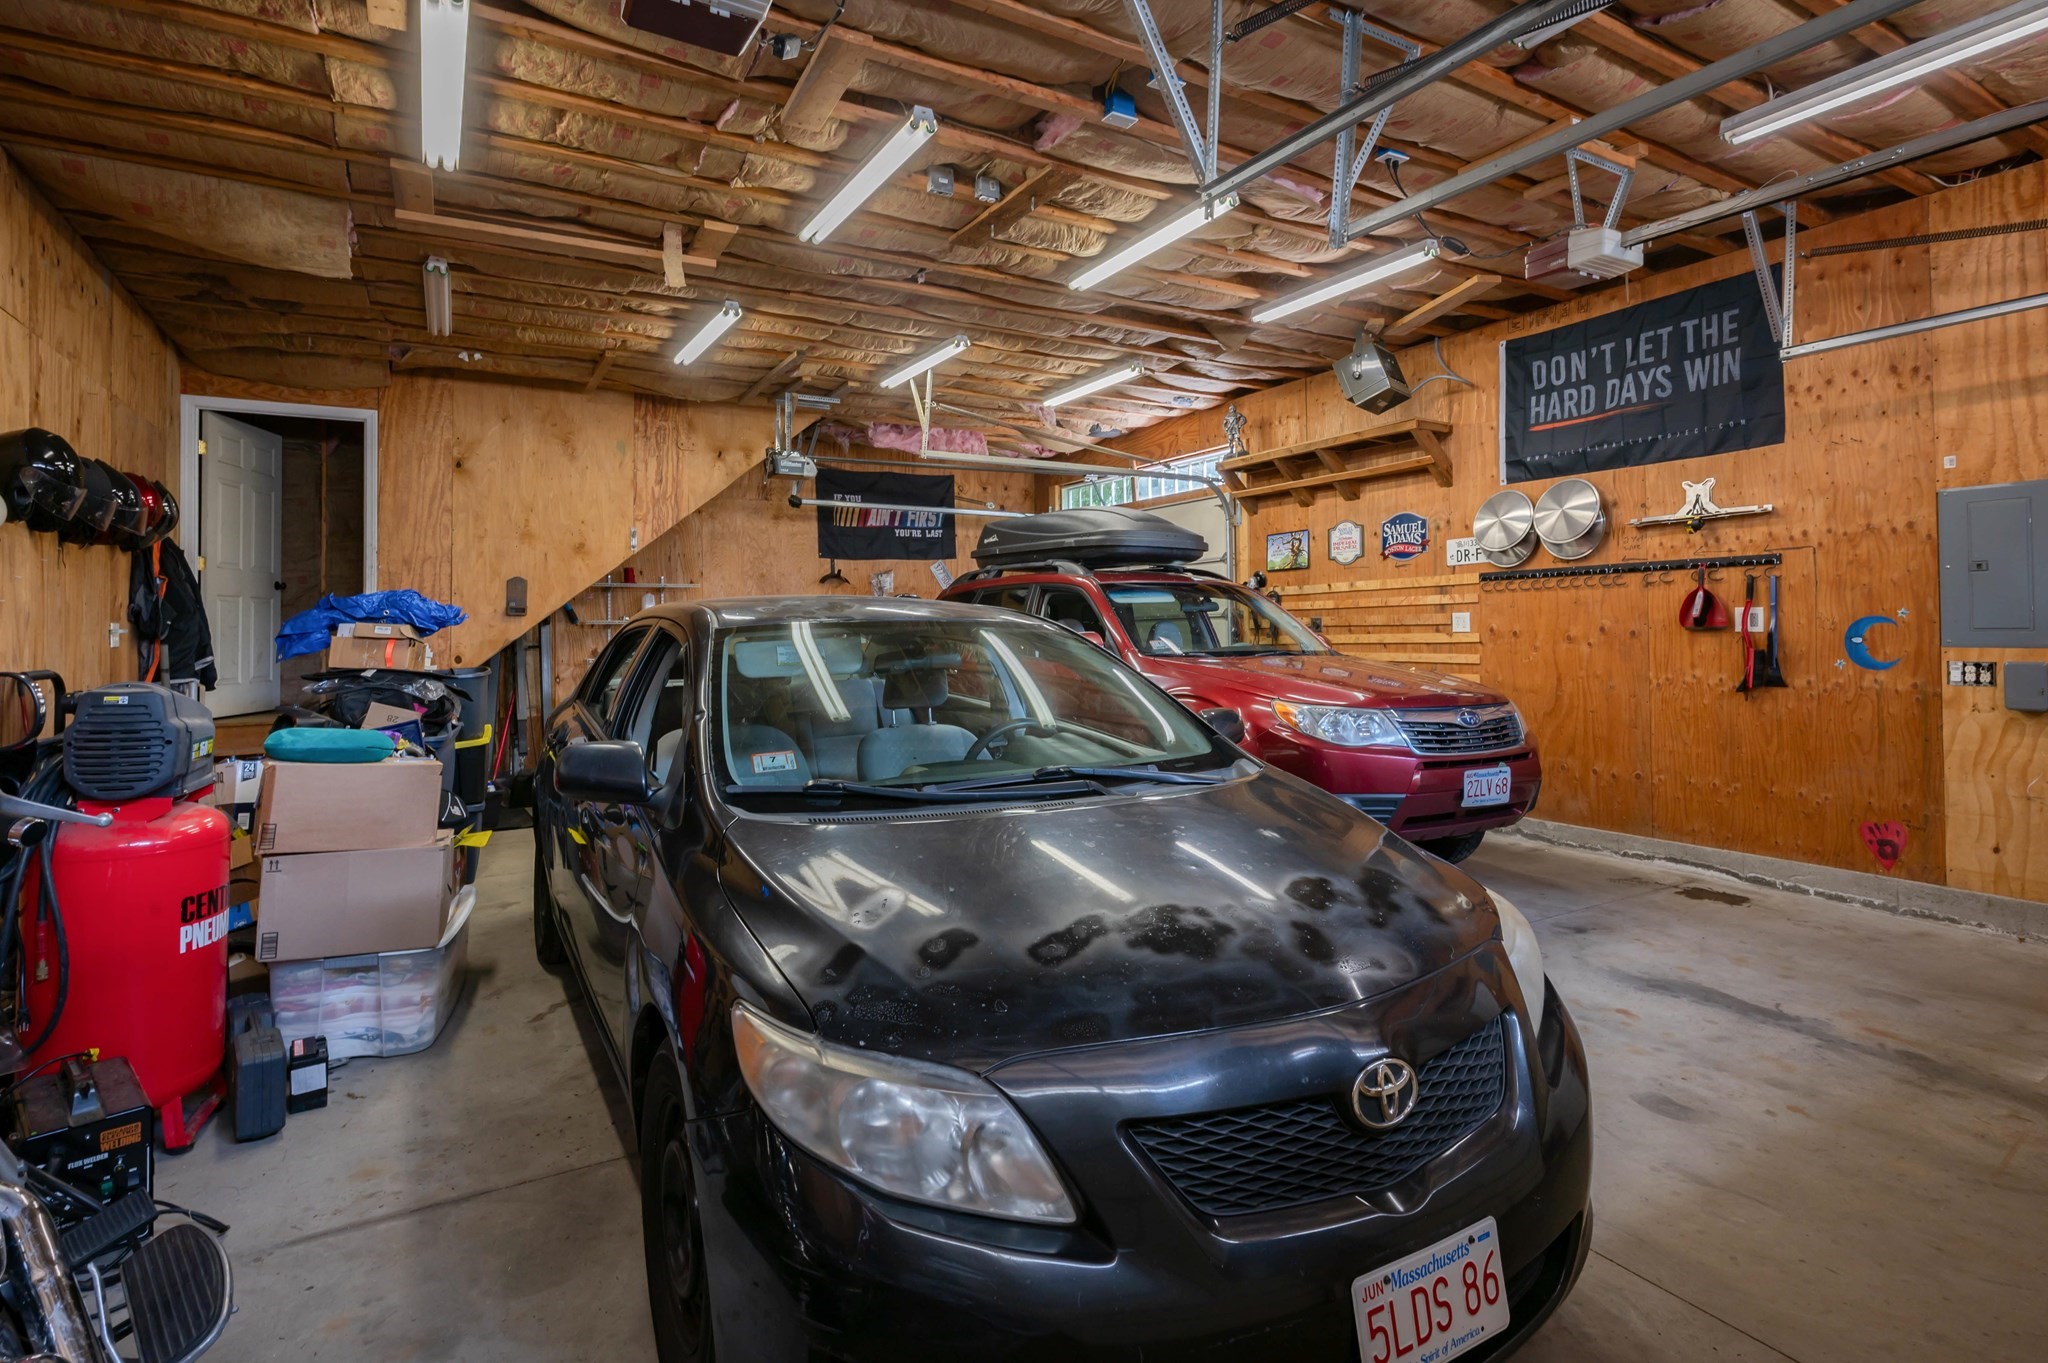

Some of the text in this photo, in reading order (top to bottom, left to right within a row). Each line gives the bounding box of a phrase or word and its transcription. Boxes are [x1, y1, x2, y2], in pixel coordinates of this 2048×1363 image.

[1532, 308, 1740, 390] DON'T LET THE
[1530, 347, 1742, 424] HARD DAYS WIN
[844, 494, 861, 503] YOU
[895, 529, 943, 538] YOU'RE LAST
[1383, 521, 1426, 537] SAMUEL
[1386, 532, 1422, 548] ADAMS
[1384, 545, 1405, 555] BOSTON
[386, 714, 400, 724] 28
[244, 763, 255, 772] 24
[1495, 777, 1508, 795] 68
[101, 1134, 141, 1152] WELDING
[84, 1152, 108, 1165] WELDER
[1362, 1241, 1470, 1303] JUN Massachusetts
[1366, 1249, 1500, 1363] 5LDS 86
[1441, 1340, 1449, 1356] of
[1450, 1327, 1481, 1350] America
